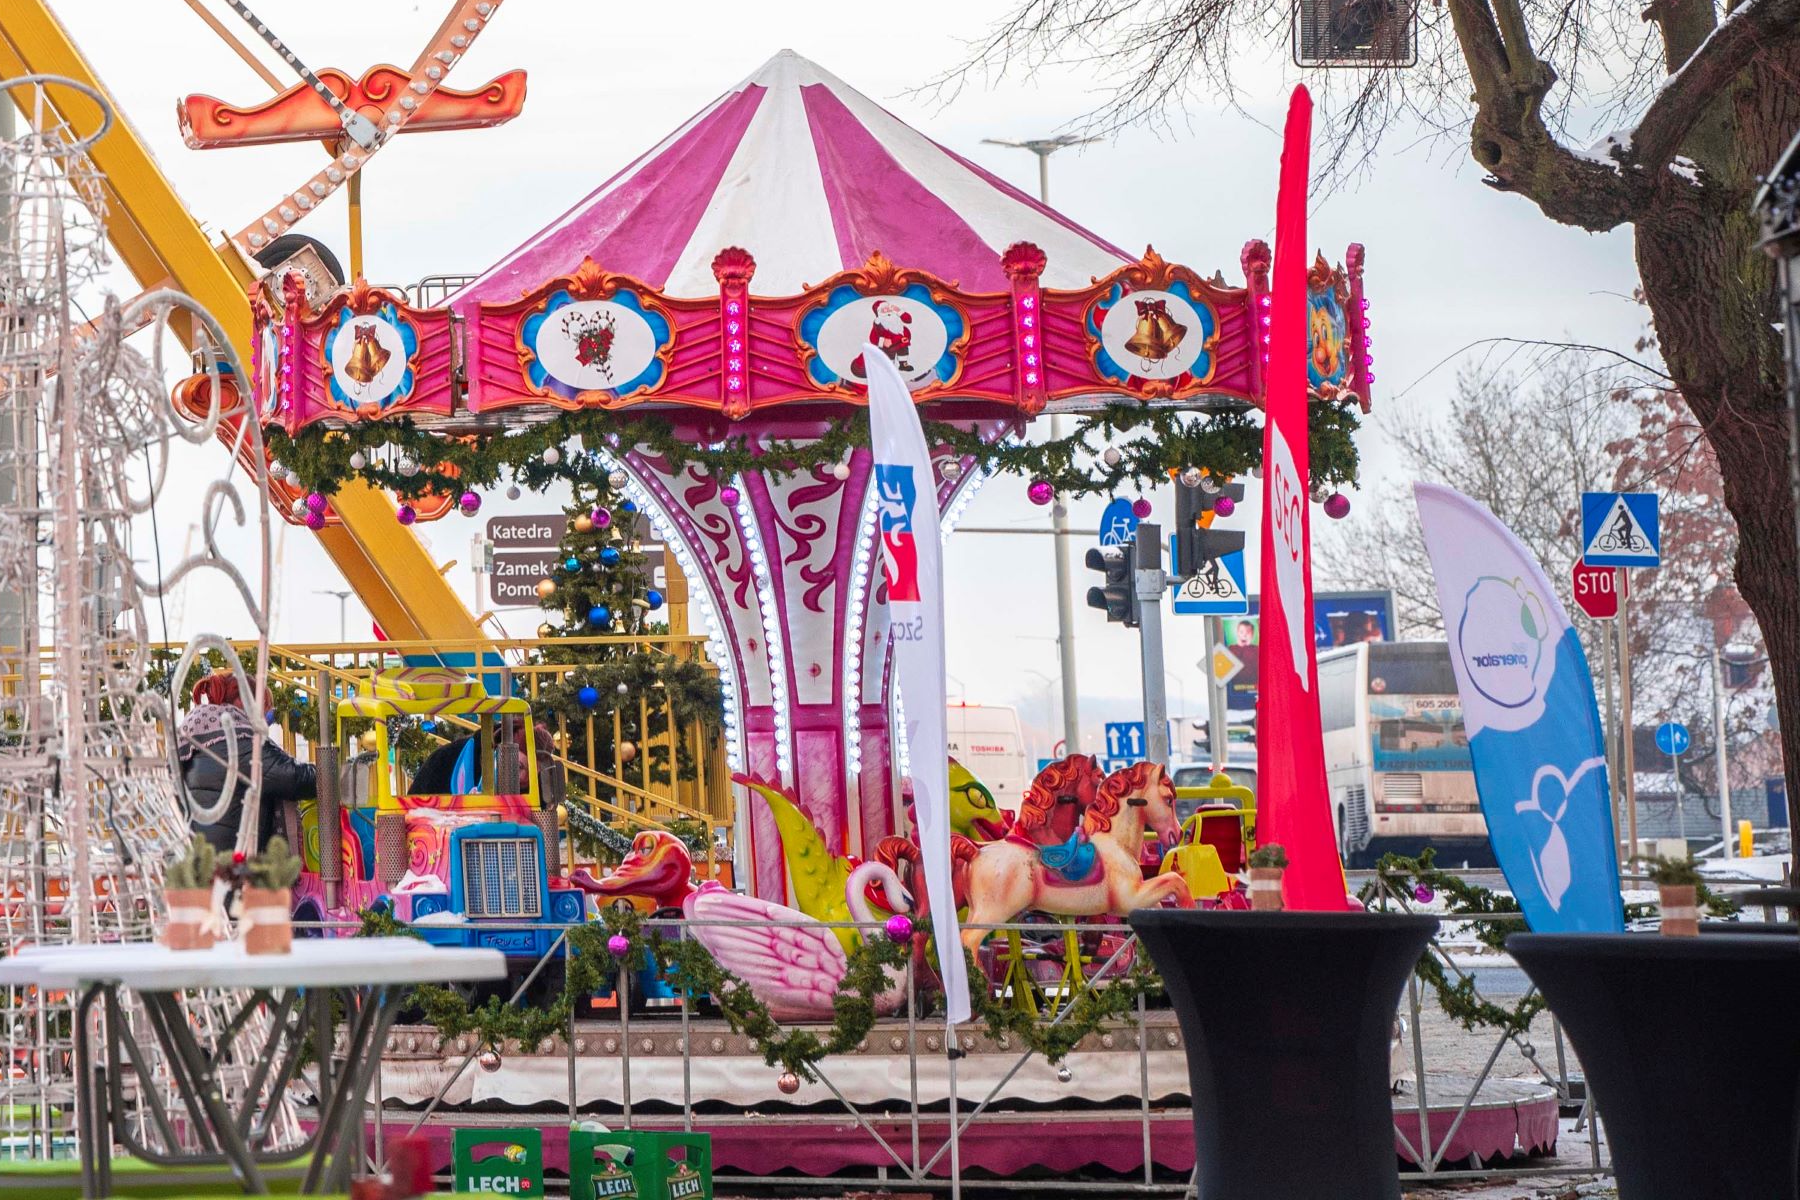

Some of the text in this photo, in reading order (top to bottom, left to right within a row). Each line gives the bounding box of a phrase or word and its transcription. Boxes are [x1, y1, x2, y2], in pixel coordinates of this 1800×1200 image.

[492, 523, 552, 539] Katedra
[496, 561, 549, 576] Zamek
[1416, 700, 1435, 709] 605
[1438, 700, 1457, 709] 206
[468, 1176, 520, 1193] LECH
[597, 1178, 632, 1196] LECH
[672, 1179, 699, 1198] LECH
